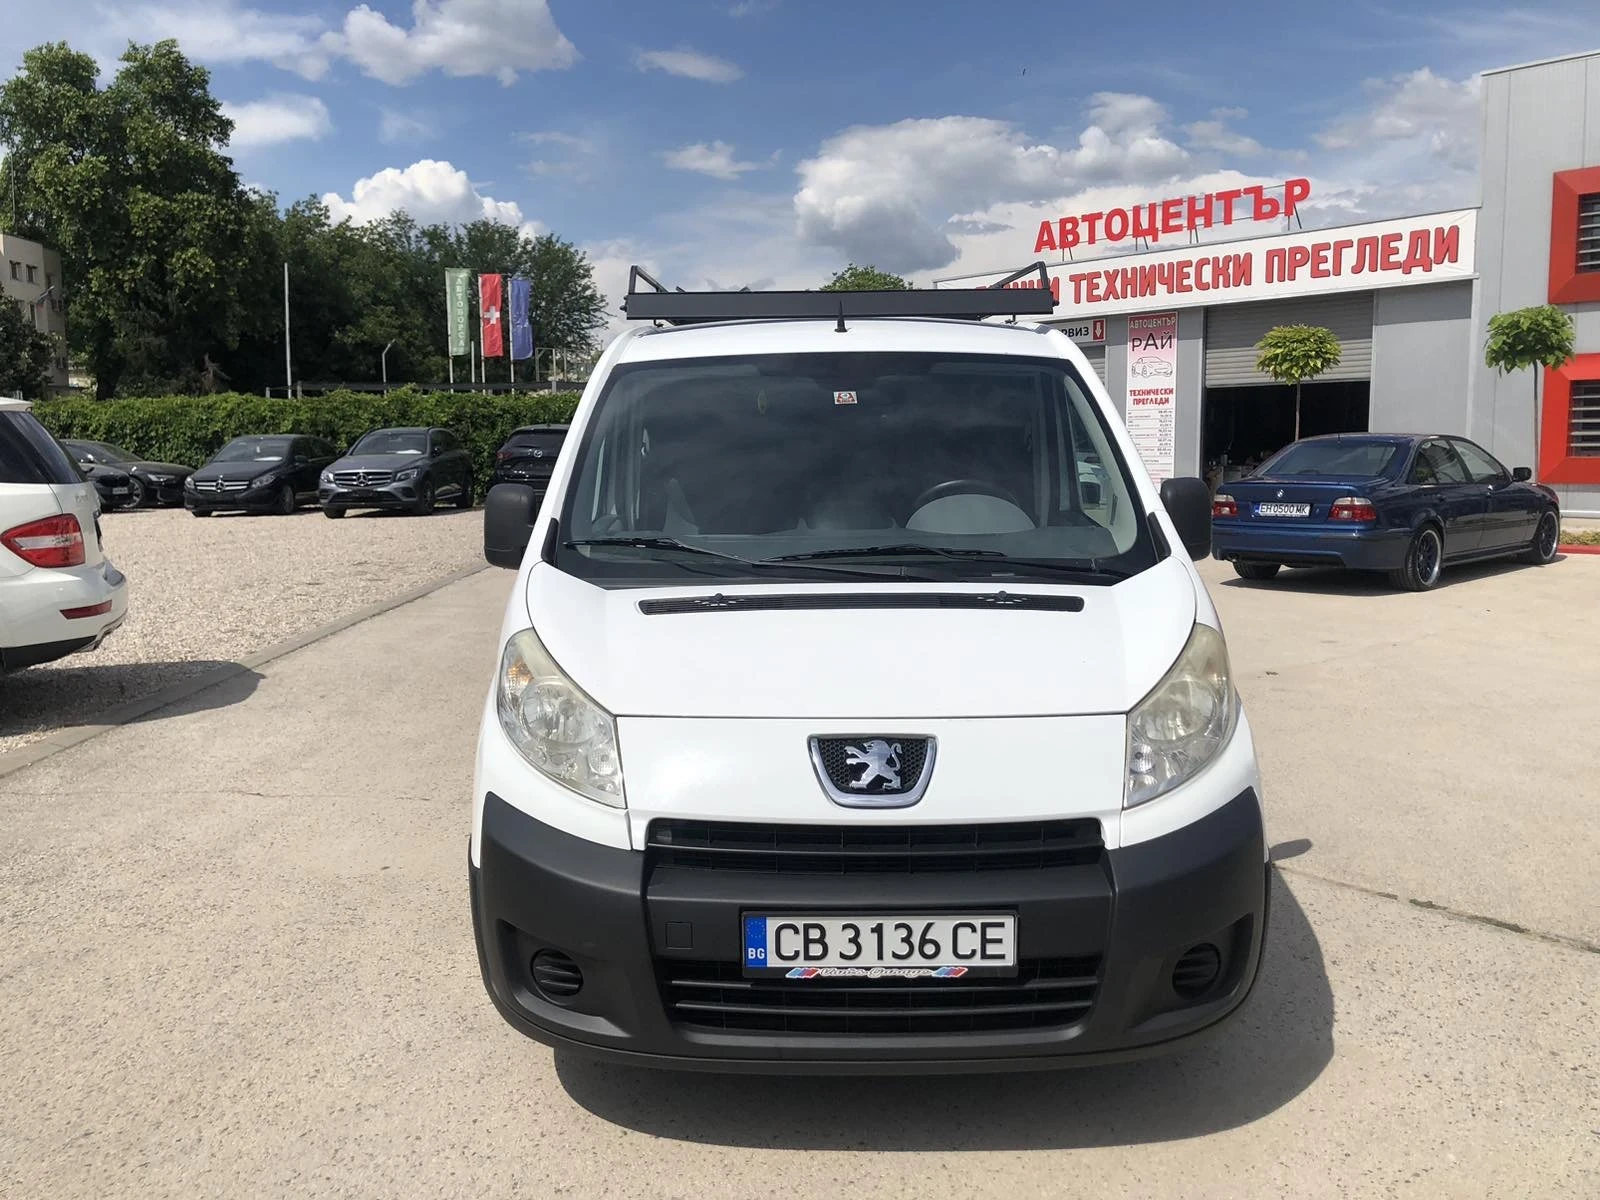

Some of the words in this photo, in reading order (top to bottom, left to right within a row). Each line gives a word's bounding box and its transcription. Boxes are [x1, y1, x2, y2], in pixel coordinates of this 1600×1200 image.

[1034, 178, 1311, 253] АВТОЦЕНТЪР
[1069, 252, 1253, 304] ТЕХНИЧЕСКИ
[1265, 225, 1460, 284] ПРЕГЛЕДИ
[1130, 316, 1176, 329] АВТОЦЕНТЪР
[1058, 326, 1090, 338] РВИЗ
[1131, 331, 1173, 352] РАЙ
[1129, 387, 1174, 397] ТЕХНИЧЕСКИ
[1133, 397, 1169, 406] ПРЕГЛЕДИ
[839, 922, 942, 961] 3136
[747, 947, 766, 960] BG
